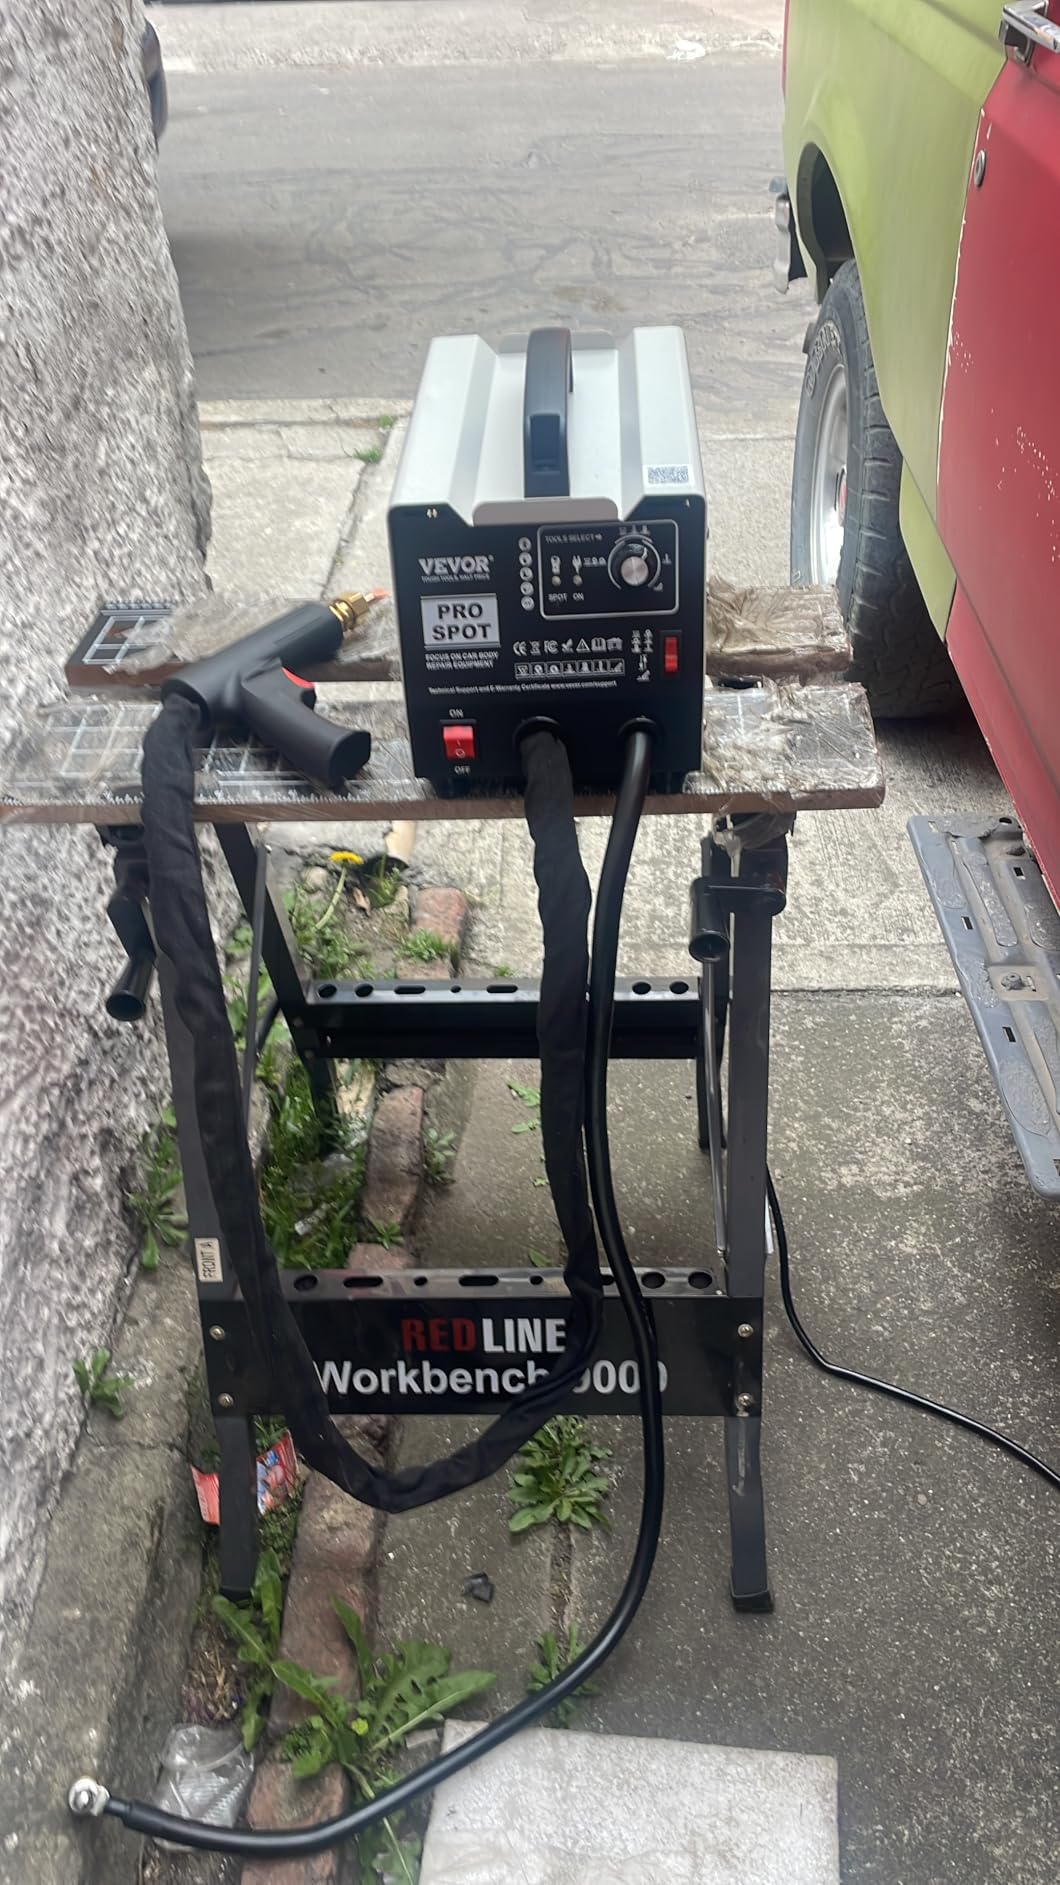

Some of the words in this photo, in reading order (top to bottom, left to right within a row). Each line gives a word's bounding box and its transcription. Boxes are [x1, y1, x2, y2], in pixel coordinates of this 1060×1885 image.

[568, 533, 594, 543] SELECT
[548, 592, 568, 602] SPOT
[573, 592, 584, 601] ON
[438, 603, 483, 619] PRO
[432, 623, 491, 640] SPOT
[425, 652, 450, 661] FOCUS
[450, 652, 462, 661] ON
[462, 651, 478, 660] CAR
[478, 650, 498, 660] BODY
[426, 661, 453, 671] REPAIR
[453, 660, 494, 670] EQUIPMENT
[448, 708, 464, 718] ON
[454, 765, 471, 775] OFF
[200, 1250, 216, 1278] FRONT
